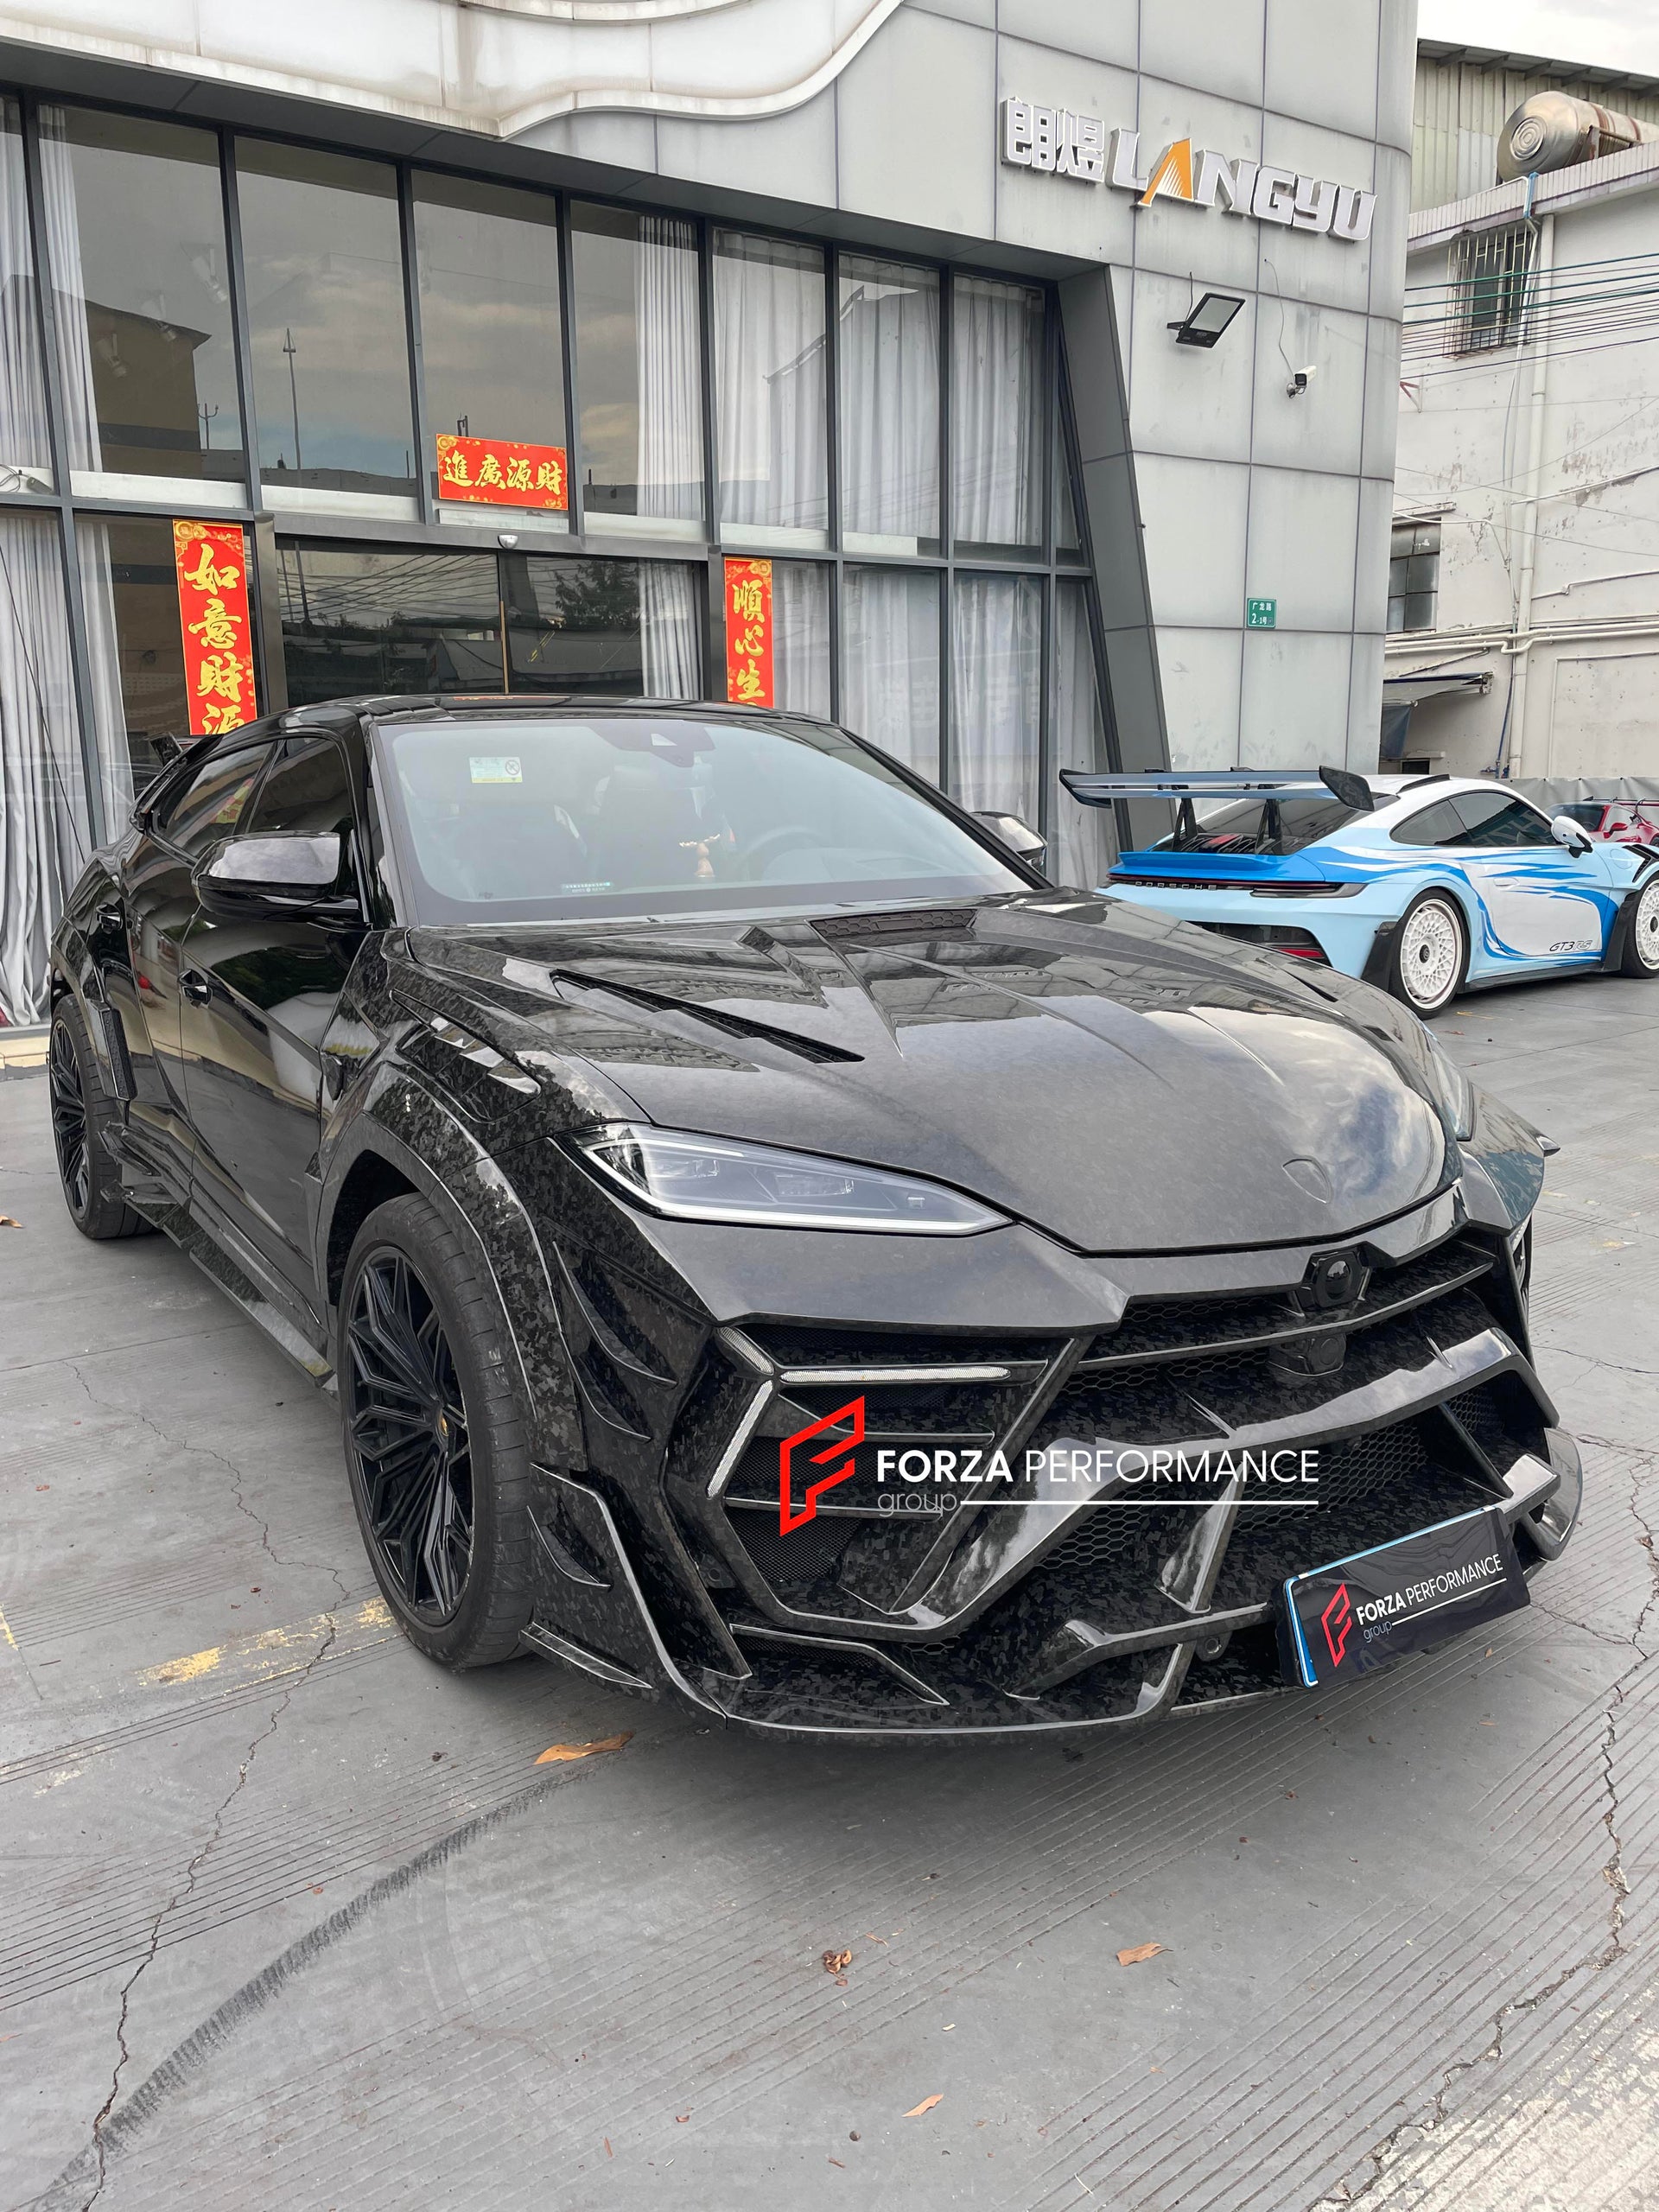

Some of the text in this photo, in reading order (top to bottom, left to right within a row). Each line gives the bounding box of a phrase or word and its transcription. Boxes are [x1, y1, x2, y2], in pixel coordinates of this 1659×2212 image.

[1106, 129, 1377, 240] LANGYU
[732, 579, 766, 707] 順心生
[1135, 880, 1217, 891] PORSCHE
[1356, 1554, 1503, 1625] FORZA PERFORMANCE
[1363, 1620, 1393, 1643] group
